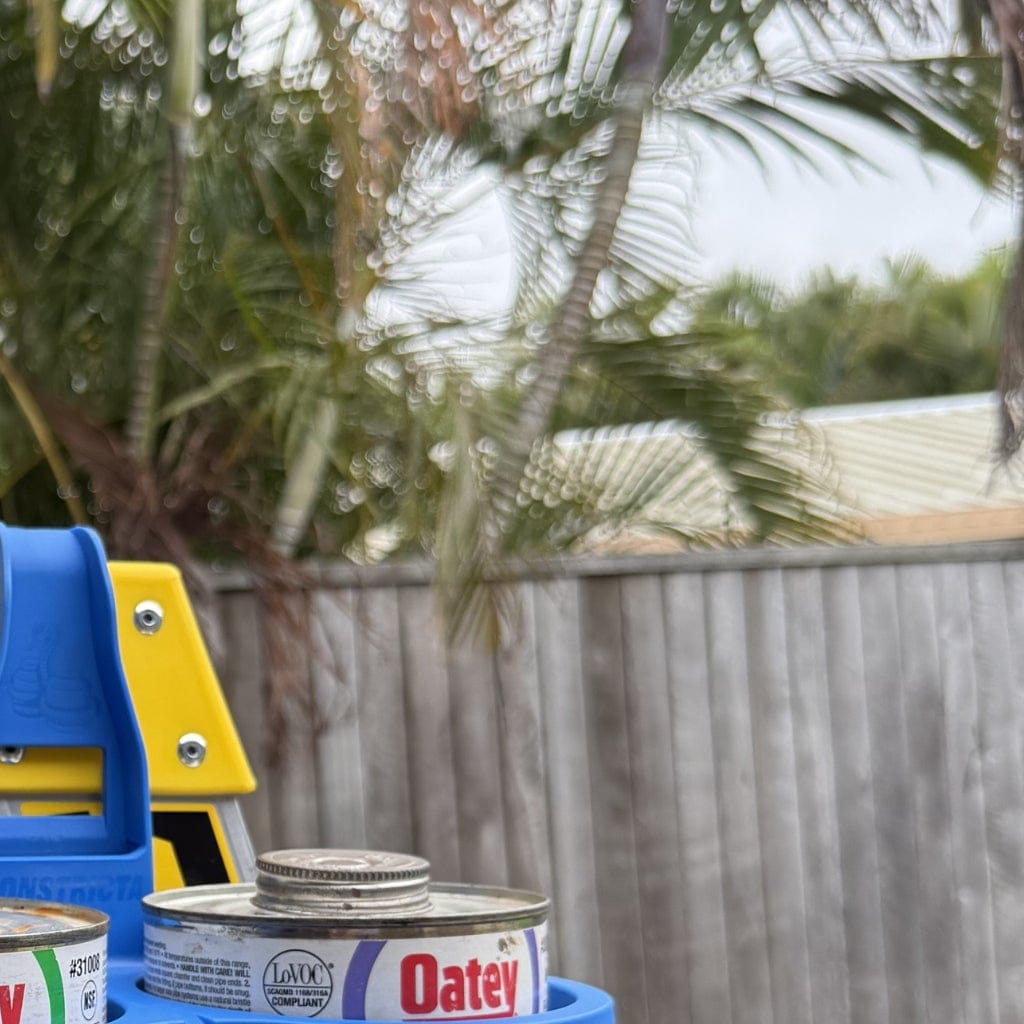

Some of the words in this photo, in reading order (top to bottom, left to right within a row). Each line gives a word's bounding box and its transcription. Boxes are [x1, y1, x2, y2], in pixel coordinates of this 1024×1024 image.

[69, 952, 100, 978] #31008
[273, 962, 323, 985] LoVOC
[400, 953, 519, 1021] Oatey
[84, 989, 96, 1010] NSF
[271, 997, 324, 1008] COMPLIANT
